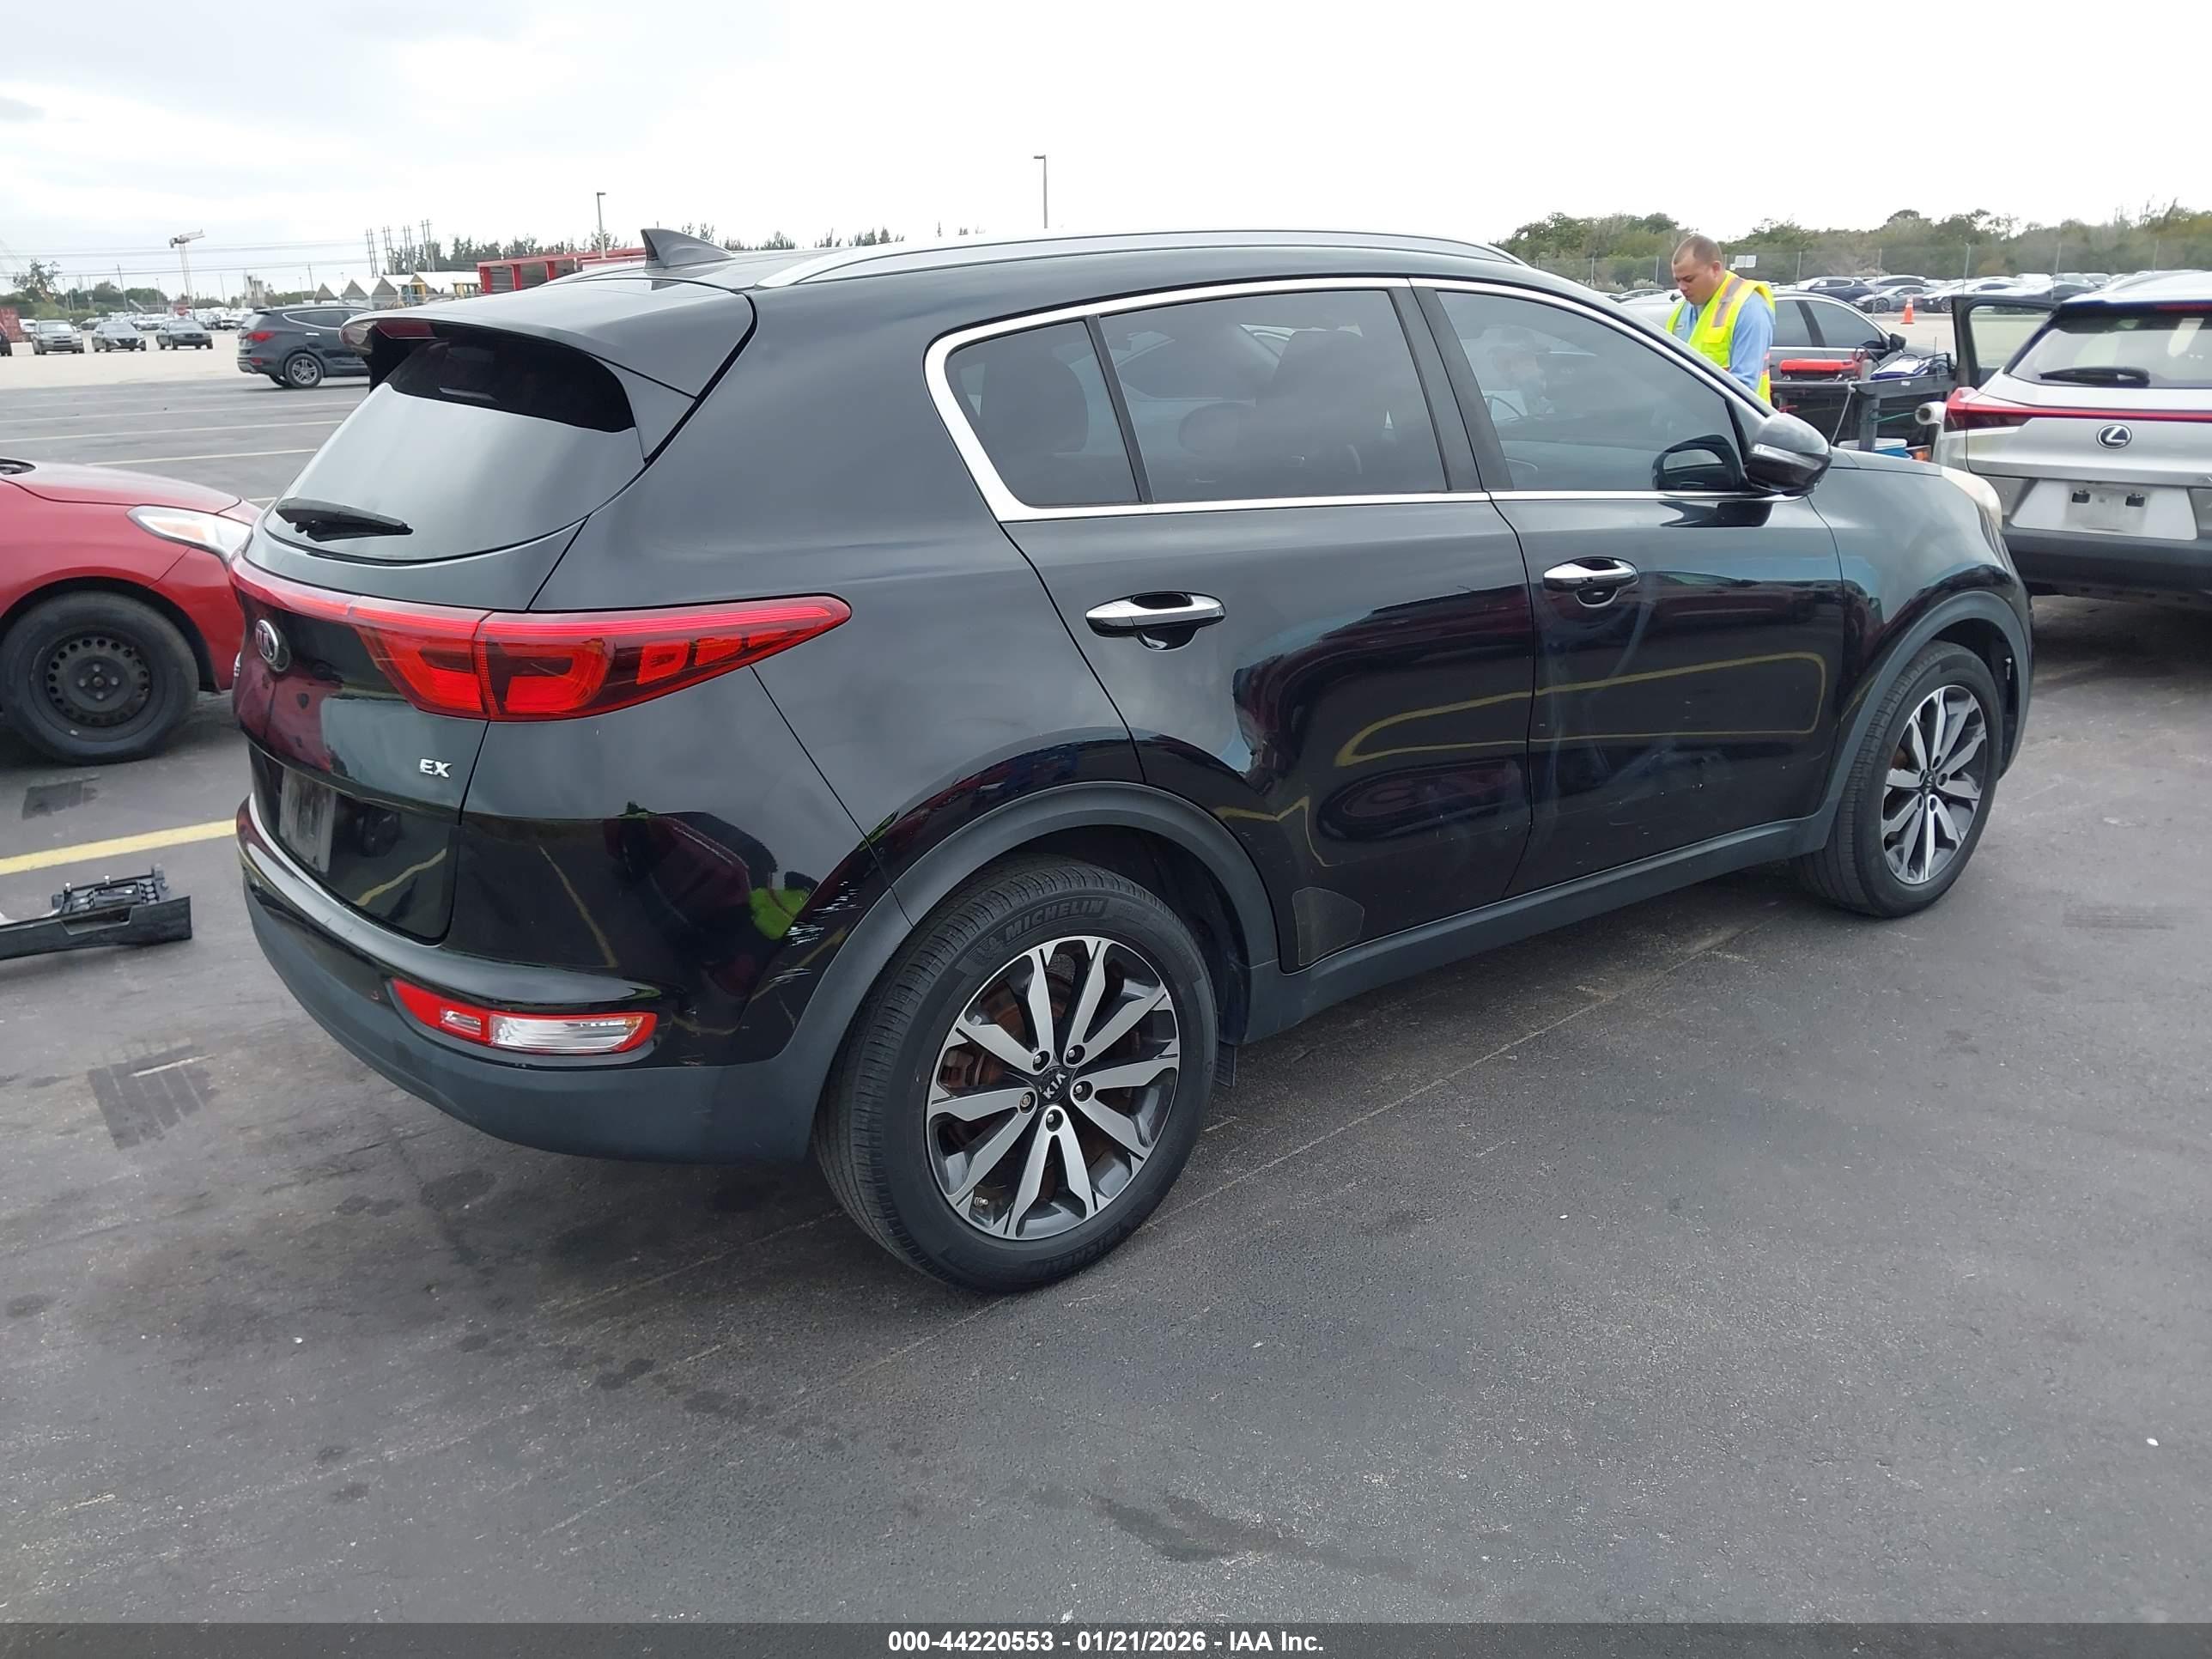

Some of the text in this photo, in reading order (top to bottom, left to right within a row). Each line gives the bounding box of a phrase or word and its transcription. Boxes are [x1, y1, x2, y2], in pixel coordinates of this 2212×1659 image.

[420, 758, 453, 778] EX
[1005, 900, 1105, 941] MICHELIN
[1042, 1073, 1066, 1099] KIA
